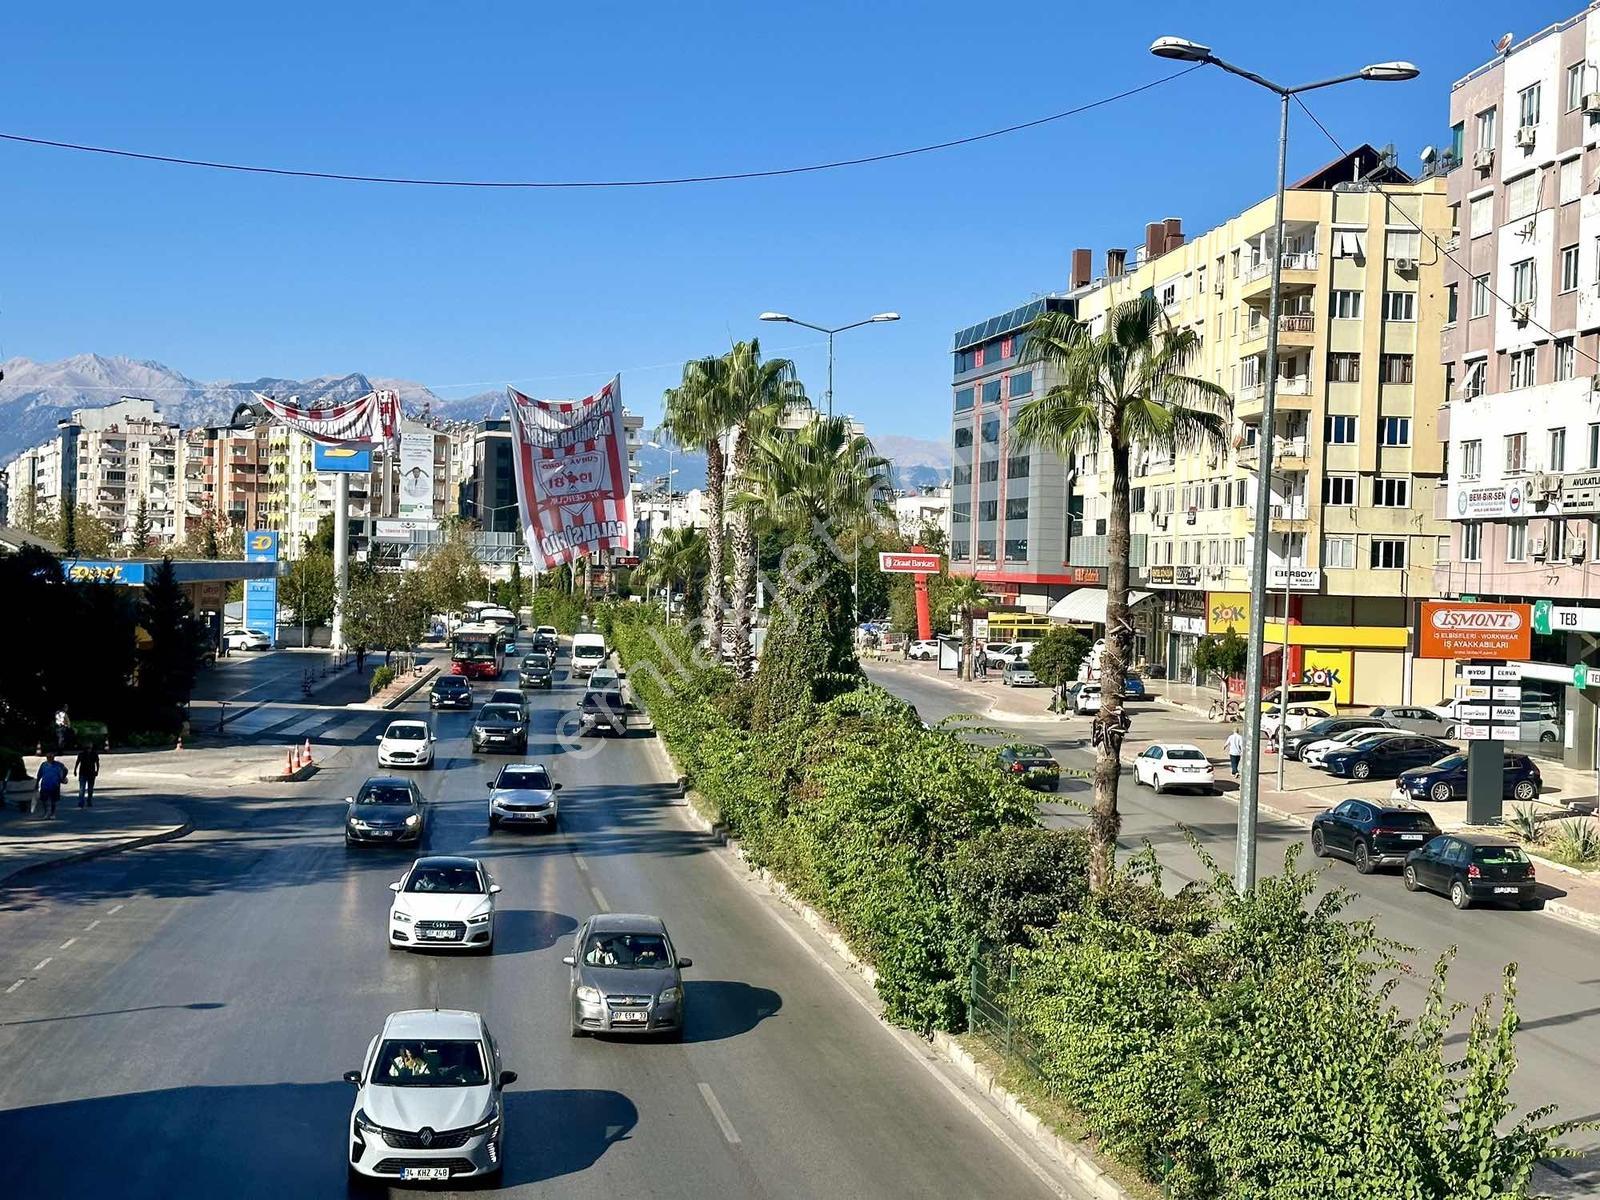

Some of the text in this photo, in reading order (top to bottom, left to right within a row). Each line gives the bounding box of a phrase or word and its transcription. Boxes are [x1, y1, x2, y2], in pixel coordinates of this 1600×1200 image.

[1560, 613, 1577, 625] TEB
[1592, 674, 1600, 683] TE
[406, 1169, 414, 1177] 34
[418, 1169, 431, 1177] KHZ
